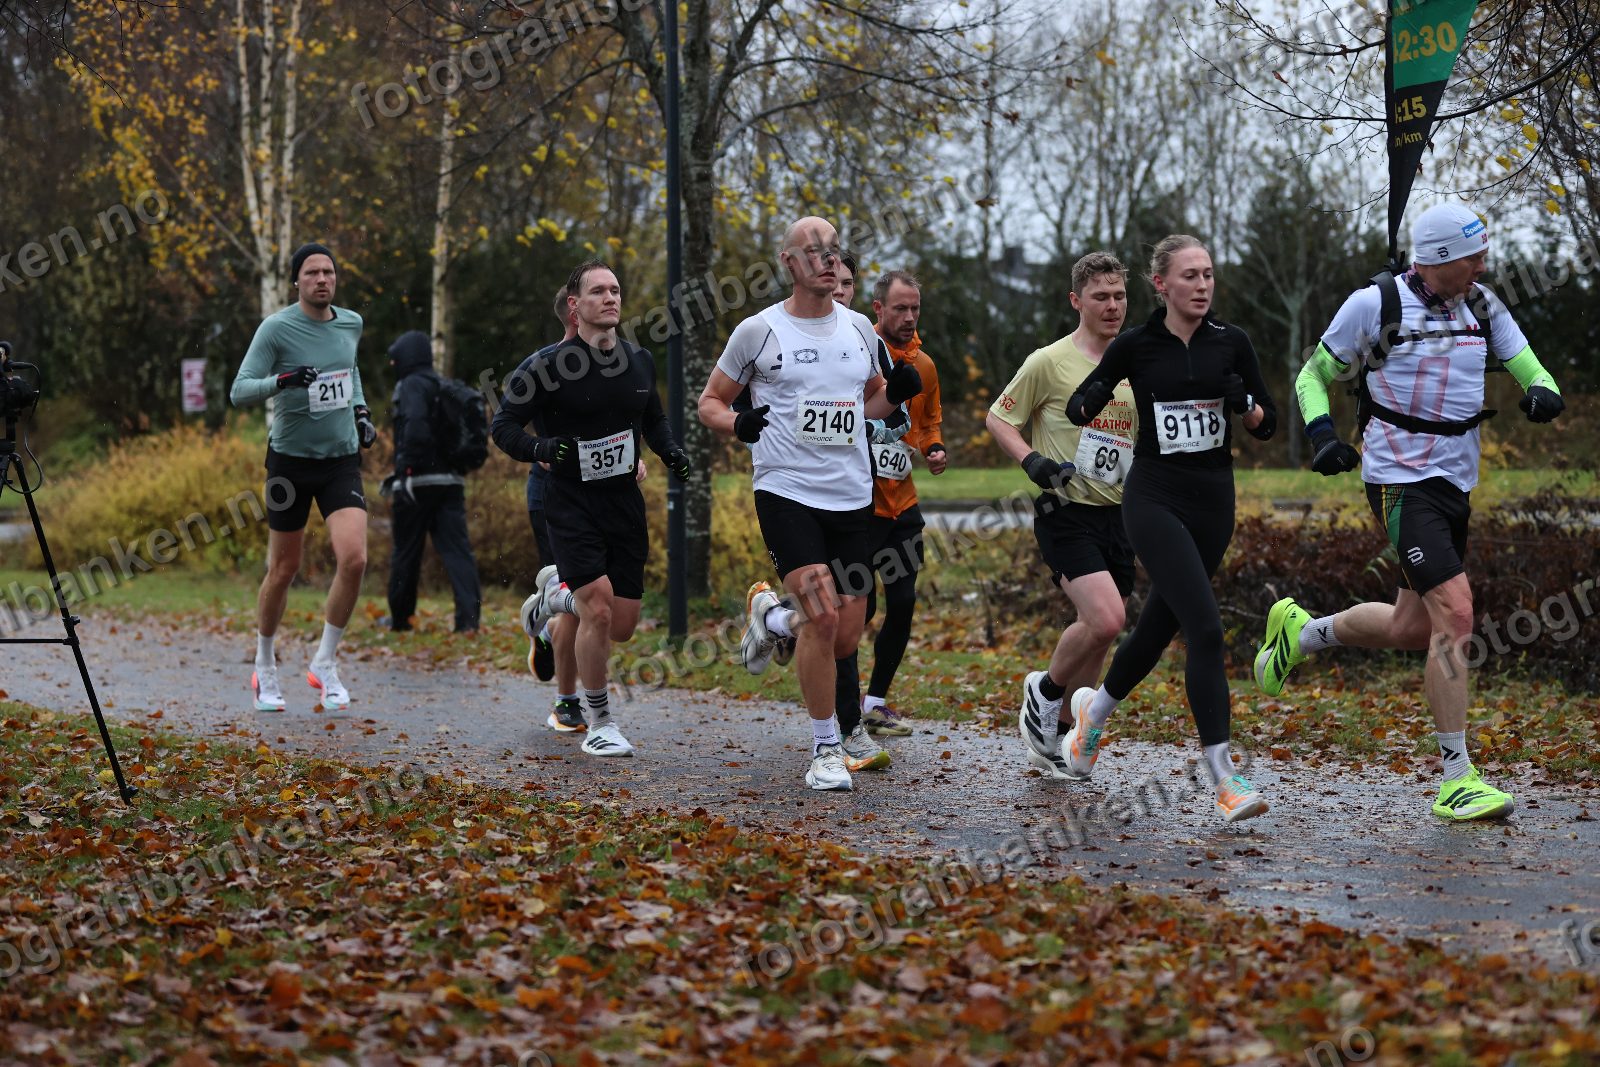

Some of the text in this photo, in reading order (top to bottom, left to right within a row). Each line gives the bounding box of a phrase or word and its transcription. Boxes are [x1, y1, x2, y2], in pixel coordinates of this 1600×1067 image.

[1393, 21, 1457, 64] 2:30
[1395, 96, 1427, 123] :15
[319, 381, 344, 401] 211
[1161, 401, 1220, 412] NORGESTESTEN
[803, 408, 855, 434] 2140
[1078, 419, 1132, 431] ARATHON
[1164, 410, 1220, 441] 9118
[583, 433, 630, 449] NORGESTESTEN
[1167, 441, 1200, 449] WINFORCE
[591, 444, 625, 470] 357
[879, 450, 907, 473] 640
[1094, 446, 1120, 472] 69
